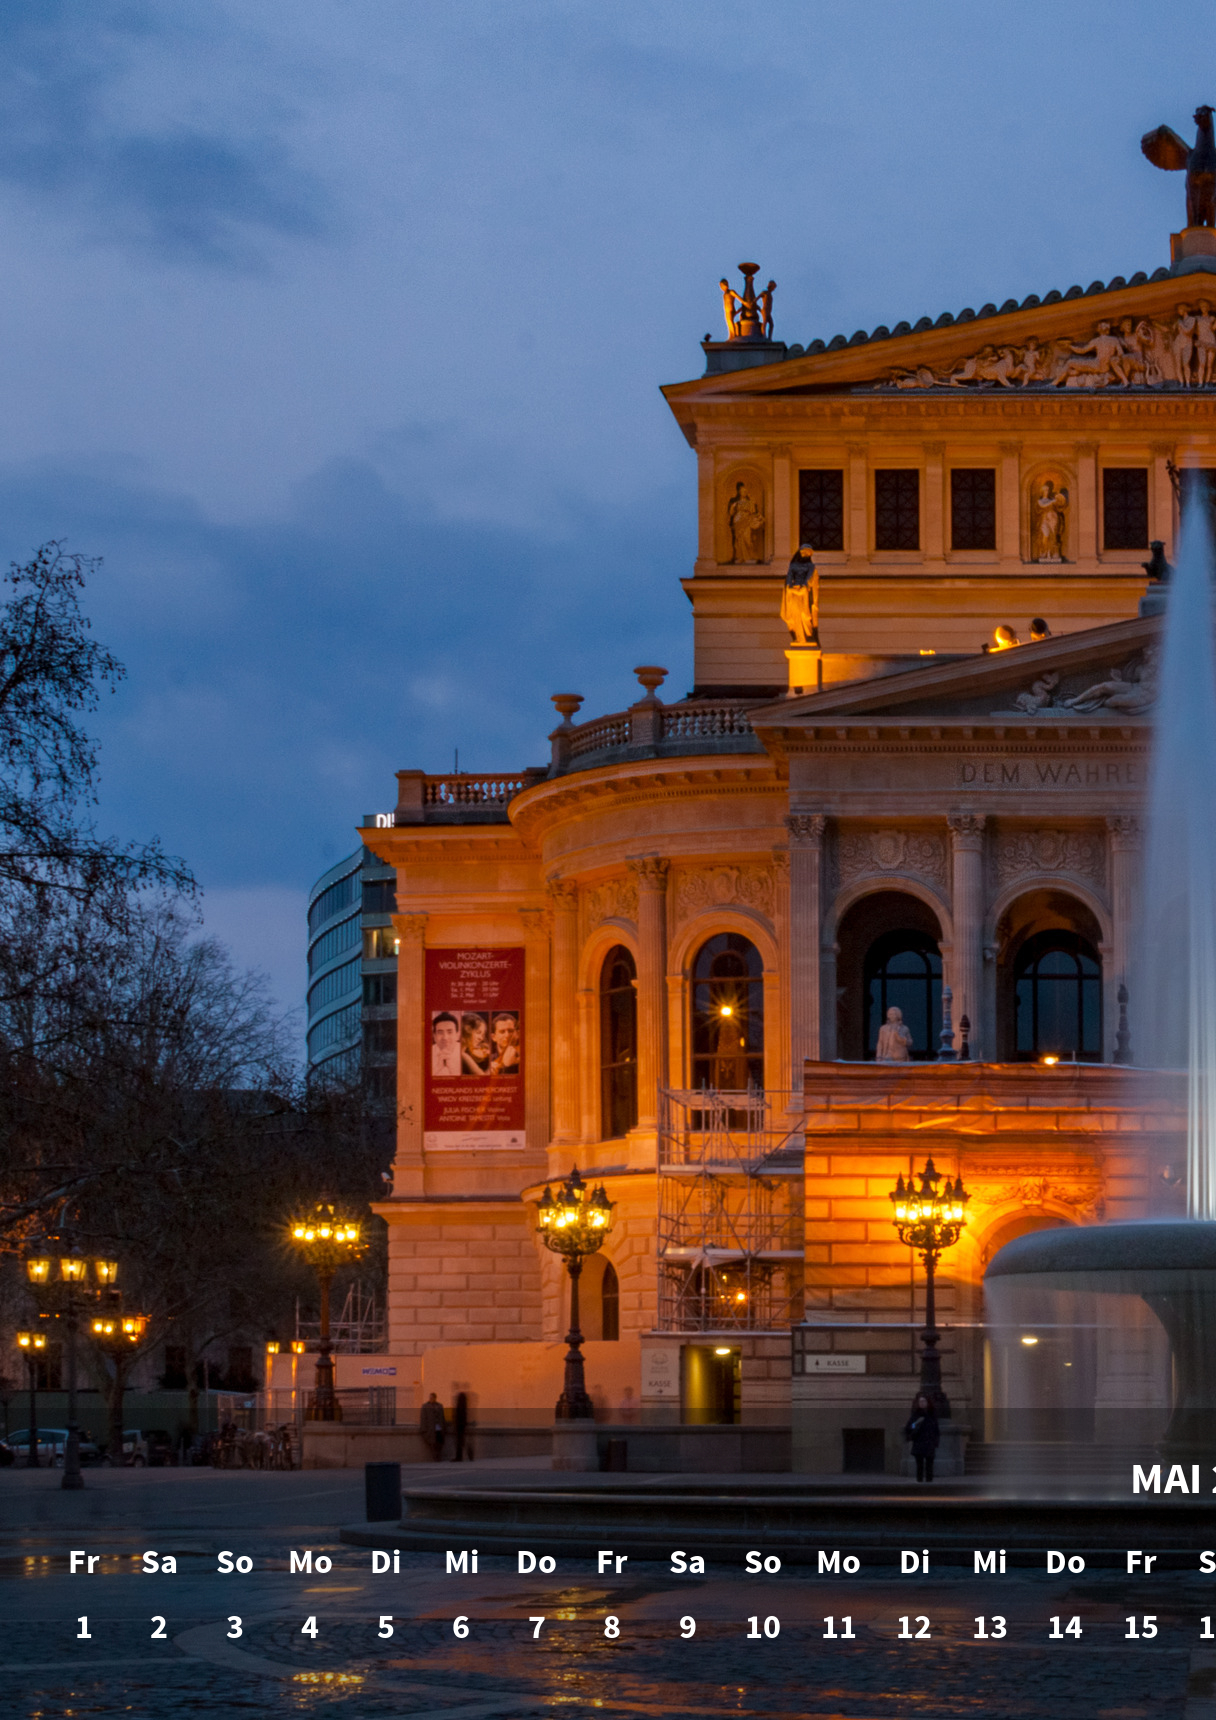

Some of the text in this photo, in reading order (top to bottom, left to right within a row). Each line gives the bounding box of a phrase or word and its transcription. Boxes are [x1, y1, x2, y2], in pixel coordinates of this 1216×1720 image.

[961, 763, 1020, 784] DEM
[460, 970, 492, 978] ZYKLUS
[648, 1380, 672, 1388] KASSE
